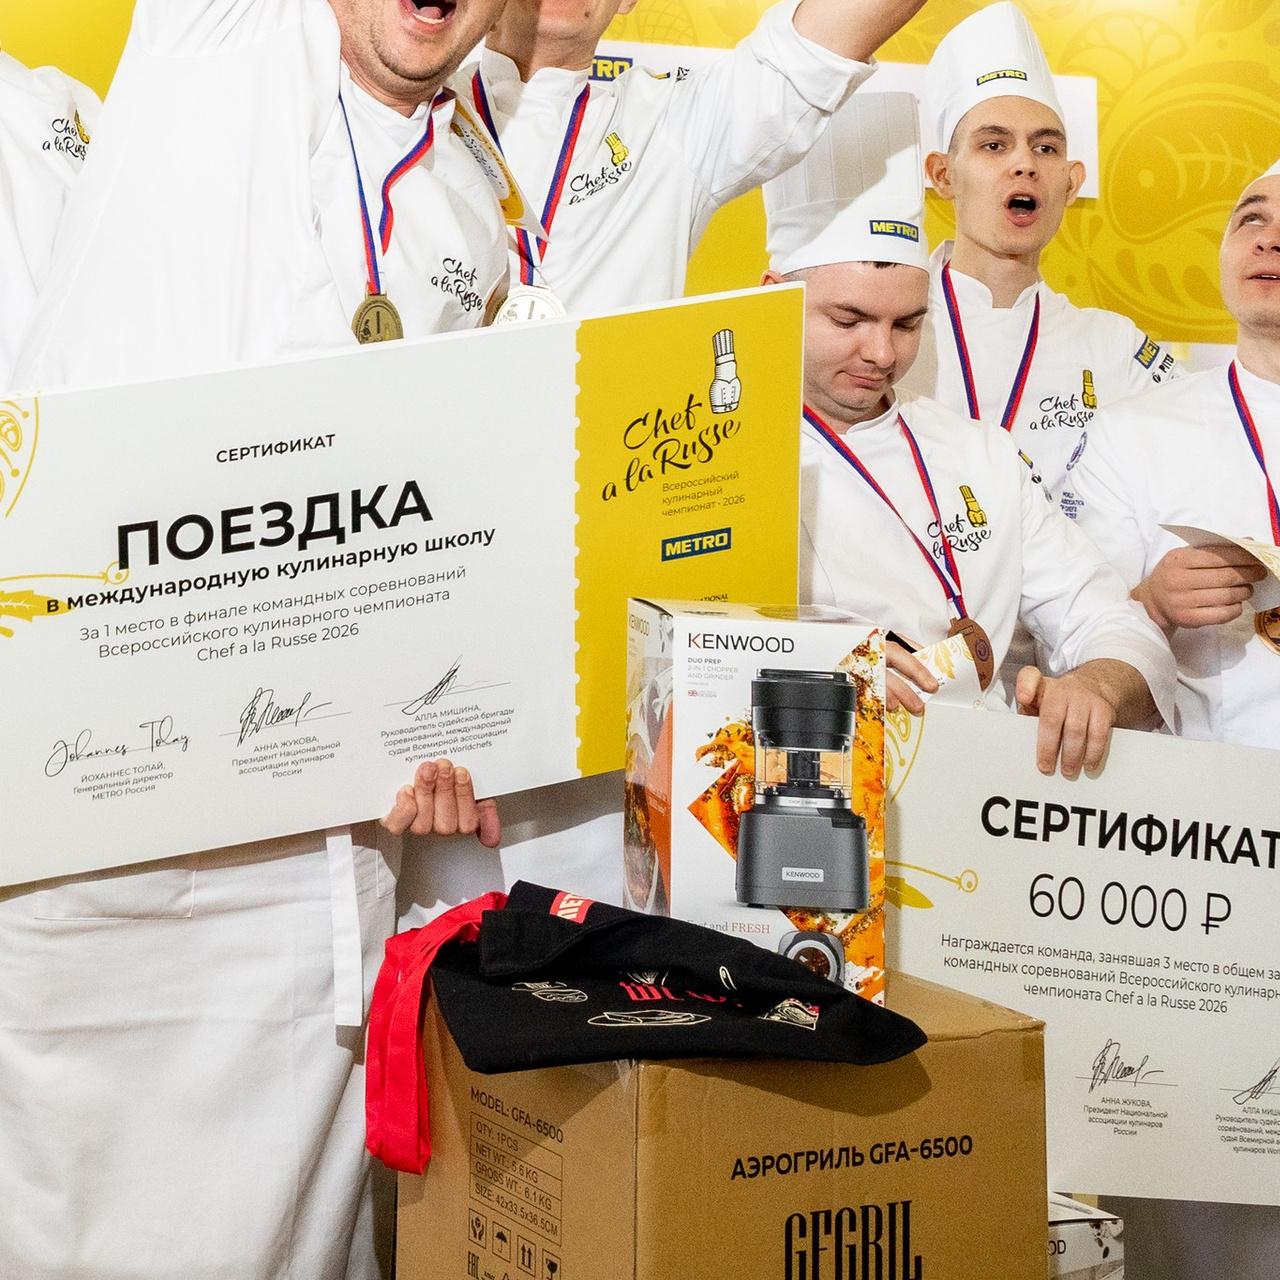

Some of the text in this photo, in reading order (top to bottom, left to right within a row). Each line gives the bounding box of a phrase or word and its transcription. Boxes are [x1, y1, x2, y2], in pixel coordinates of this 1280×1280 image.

[589, 58, 629, 78] TRO
[978, 70, 1026, 84] METRO
[570, 167, 609, 193] Chef
[872, 221, 918, 239] METRO
[442, 257, 478, 287] Chef
[431, 275, 483, 312] a la Russe
[1039, 394, 1079, 412] Chef
[623, 393, 702, 450] Chef
[1030, 410, 1094, 430] a la Russe
[215, 433, 336, 464] СЕРТИФИКАТ
[601, 419, 741, 501] a la Russe
[662, 470, 740, 492] Всероссийский
[661, 494, 745, 517] чемпионат 2026
[662, 486, 723, 506] кулинарный
[117, 479, 434, 570] ПОЕЗДКА
[665, 532, 728, 558] METRO
[47, 528, 496, 613] в международную кулинарную школу
[79, 565, 466, 641] За 1 место в финале командных соревнований
[98, 589, 450, 658] Всероссийского кулинарного чемпионата
[197, 622, 360, 662] Chef a la Russe 2026
[688, 632, 795, 654] KENWOOD
[704, 673, 734, 681] GRINDER
[707, 665, 739, 673] CHOPPER
[380, 708, 515, 739] Руководитель судейской бригады
[414, 704, 482, 722] АЛЛА МИШИНА,
[253, 735, 320, 753] АННА ЖУКОВА,
[384, 717, 512, 747] соревнований, международный
[388, 729, 508, 757] судья Всемирной ассоциации
[231, 740, 341, 767] Президент Национальной
[238, 752, 335, 775] ассоциации кулинаров
[404, 740, 493, 763] кулинаров Worldchefs
[73, 771, 174, 795] Генеральный директор
[80, 761, 166, 784] ЙОХАННЕС ТОЛАЙ,
[272, 768, 303, 779] России
[91, 784, 156, 801] METRO Россия
[980, 795, 1280, 870] СЕРТИФИКАТ
[785, 870, 820, 879] KENWOOD
[1028, 872, 1085, 921] 60
[1099, 880, 1188, 932] 000
[731, 922, 770, 934] FRESH
[941, 933, 1265, 979] Награждается команда, занявшая 3 место в общем
[943, 956, 1019, 974] командных
[1021, 963, 1116, 983] соревнований
[1119, 971, 1221, 994] Всероссийского
[1023, 983, 1228, 1013] чемпионата Chef a la Russe 2026
[470, 1087, 564, 1144] MODEL: GFA-6500
[476, 1121, 519, 1152] QTY: 1PCS
[475, 1142, 492, 1160] NET
[511, 1159, 524, 1176] 5.6
[525, 1169, 539, 1184] KG
[730, 1134, 973, 1181] АЭРОГРИЛЬ GFA-6500
[474, 1160, 504, 1186] GROSS
[524, 1186, 537, 1203] 6.1
[538, 1195, 552, 1211] KG
[474, 1181, 496, 1202] SIZE:
